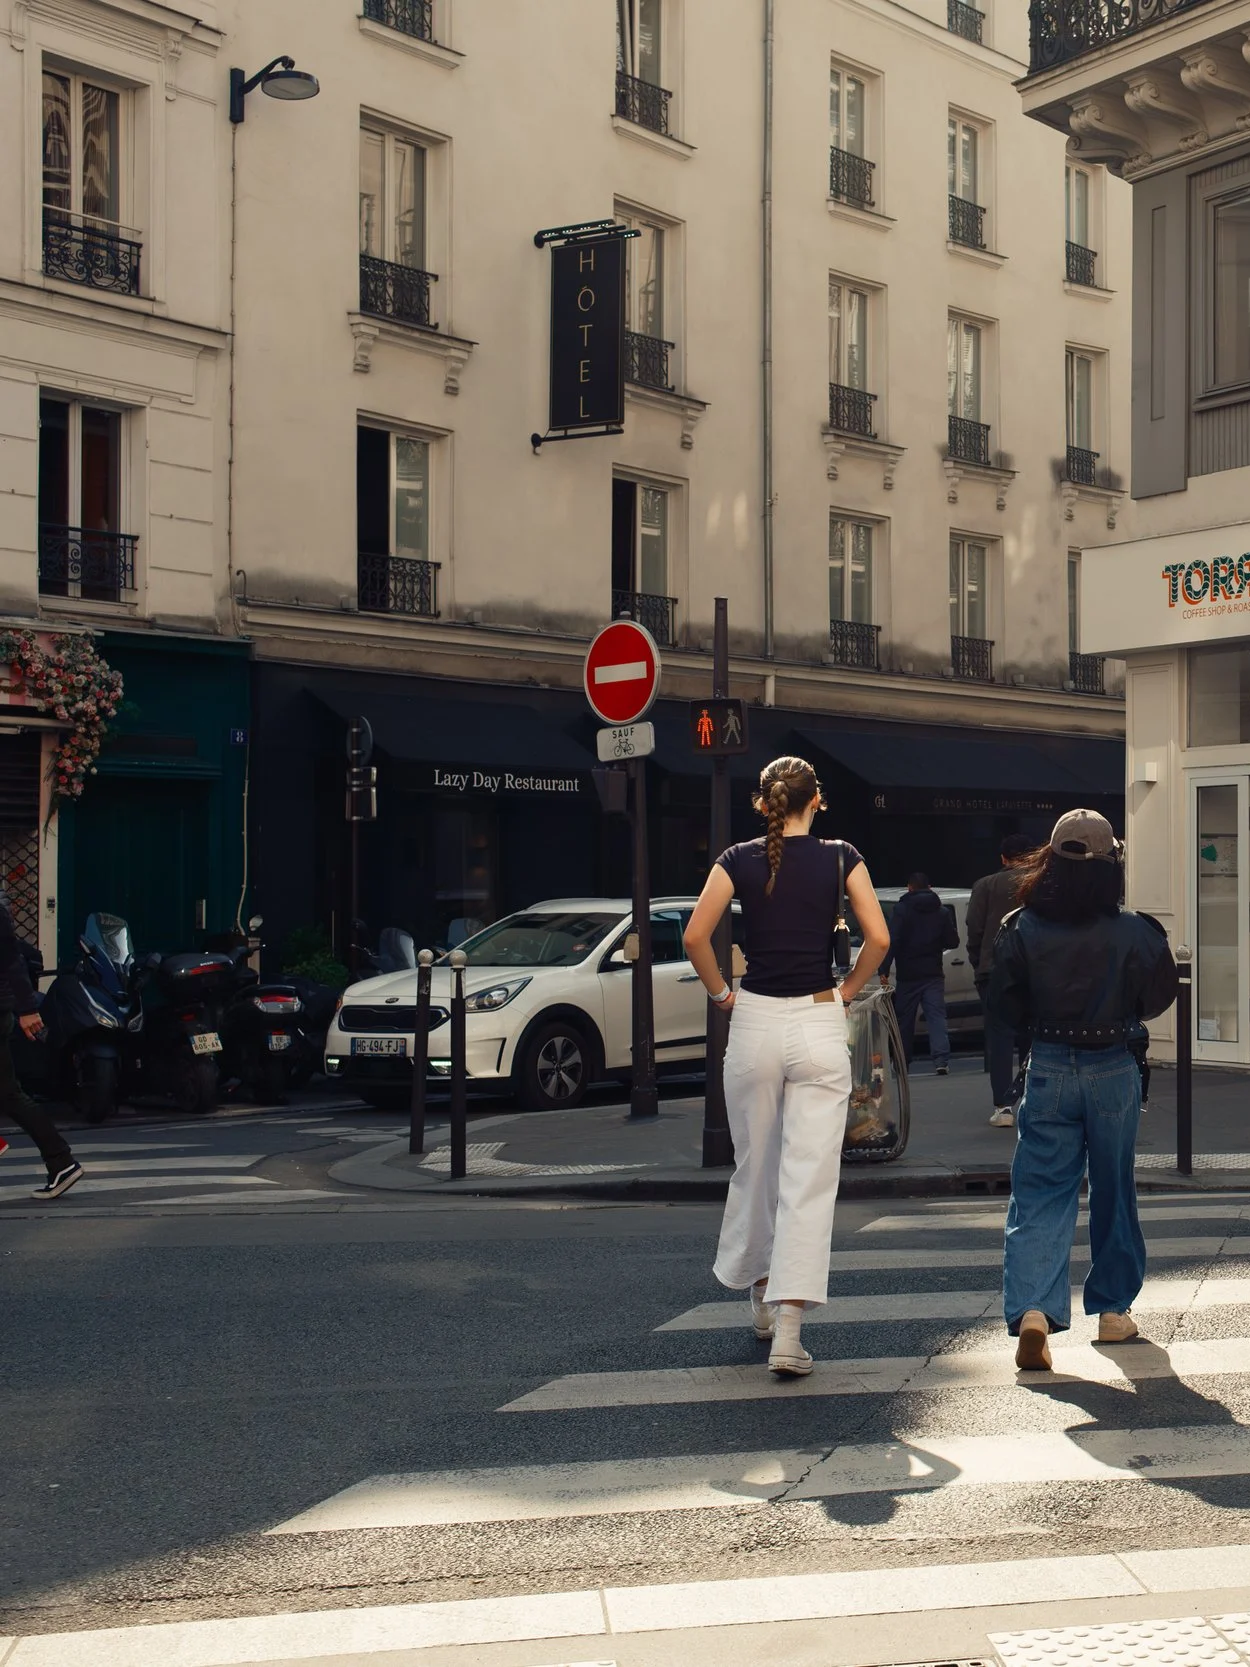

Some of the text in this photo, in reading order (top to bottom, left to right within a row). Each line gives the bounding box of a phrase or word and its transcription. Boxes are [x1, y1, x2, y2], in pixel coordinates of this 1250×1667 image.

[1182, 607, 1207, 620] COFFEE
[1208, 605, 1226, 617] SHOP
[1227, 604, 1233, 614] &
[236, 731, 244, 743] 8
[612, 727, 635, 739] SAUF
[434, 769, 580, 793] Lazy Day Restaurant
[356, 1040, 399, 1053] HG-494-FJ
